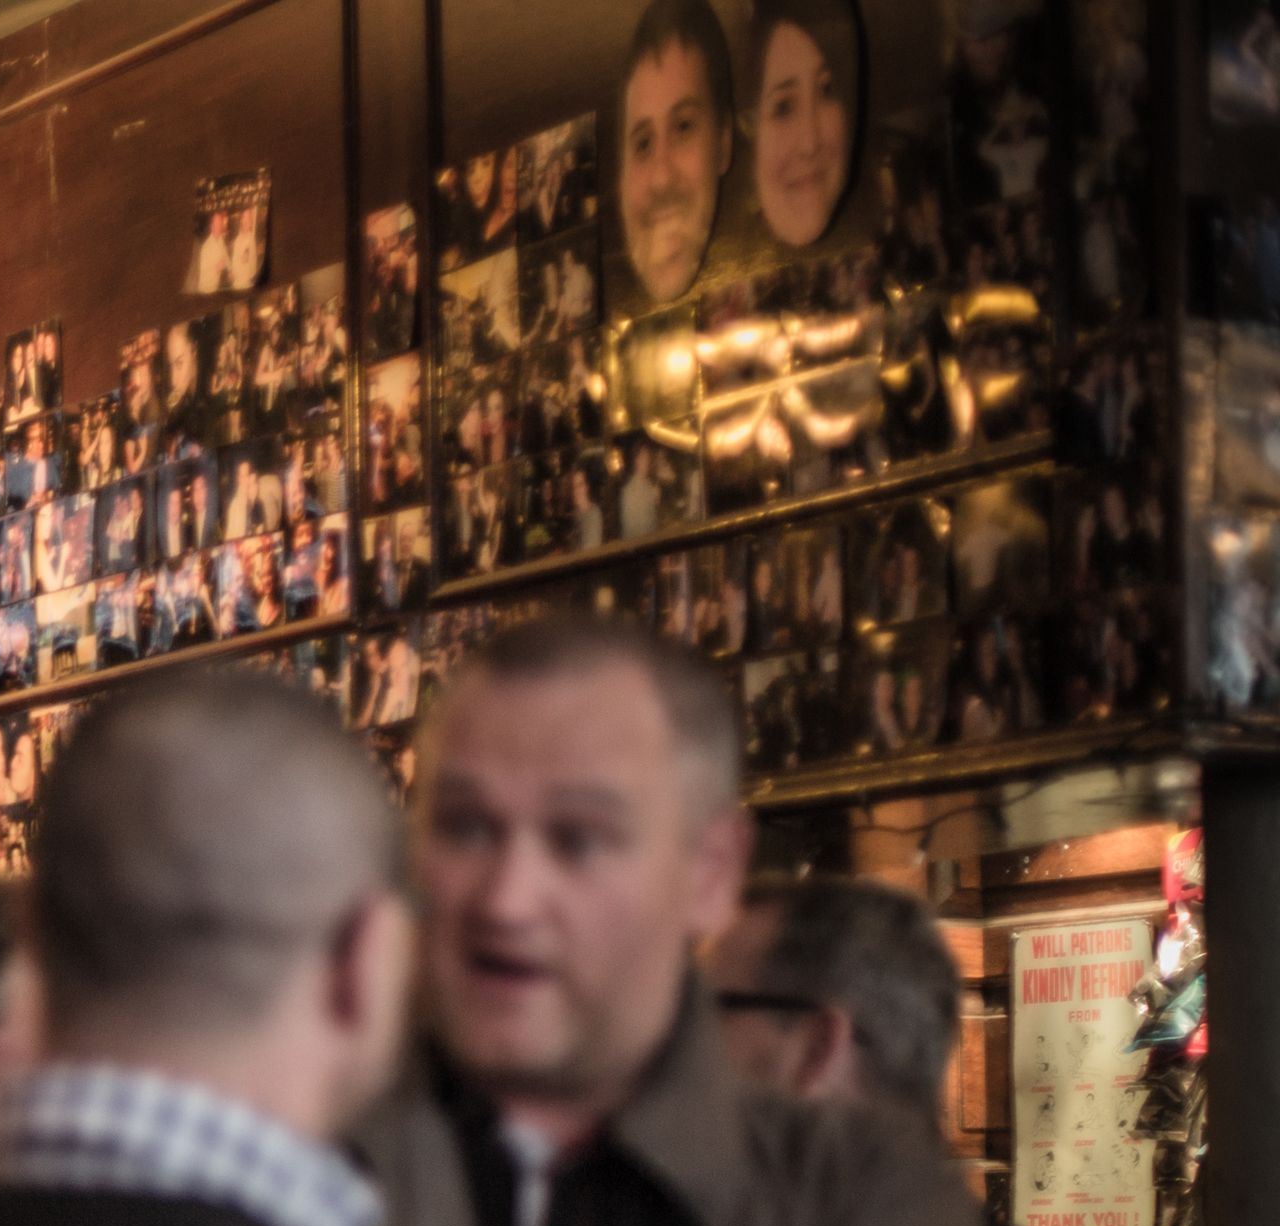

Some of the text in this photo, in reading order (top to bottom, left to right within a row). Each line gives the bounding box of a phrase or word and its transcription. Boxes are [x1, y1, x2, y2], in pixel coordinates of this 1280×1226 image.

[1031, 927, 1133, 959] WILL PATRONS
[1023, 966, 1076, 1005] KINDLY
[1068, 1008, 1101, 1023] FROM
